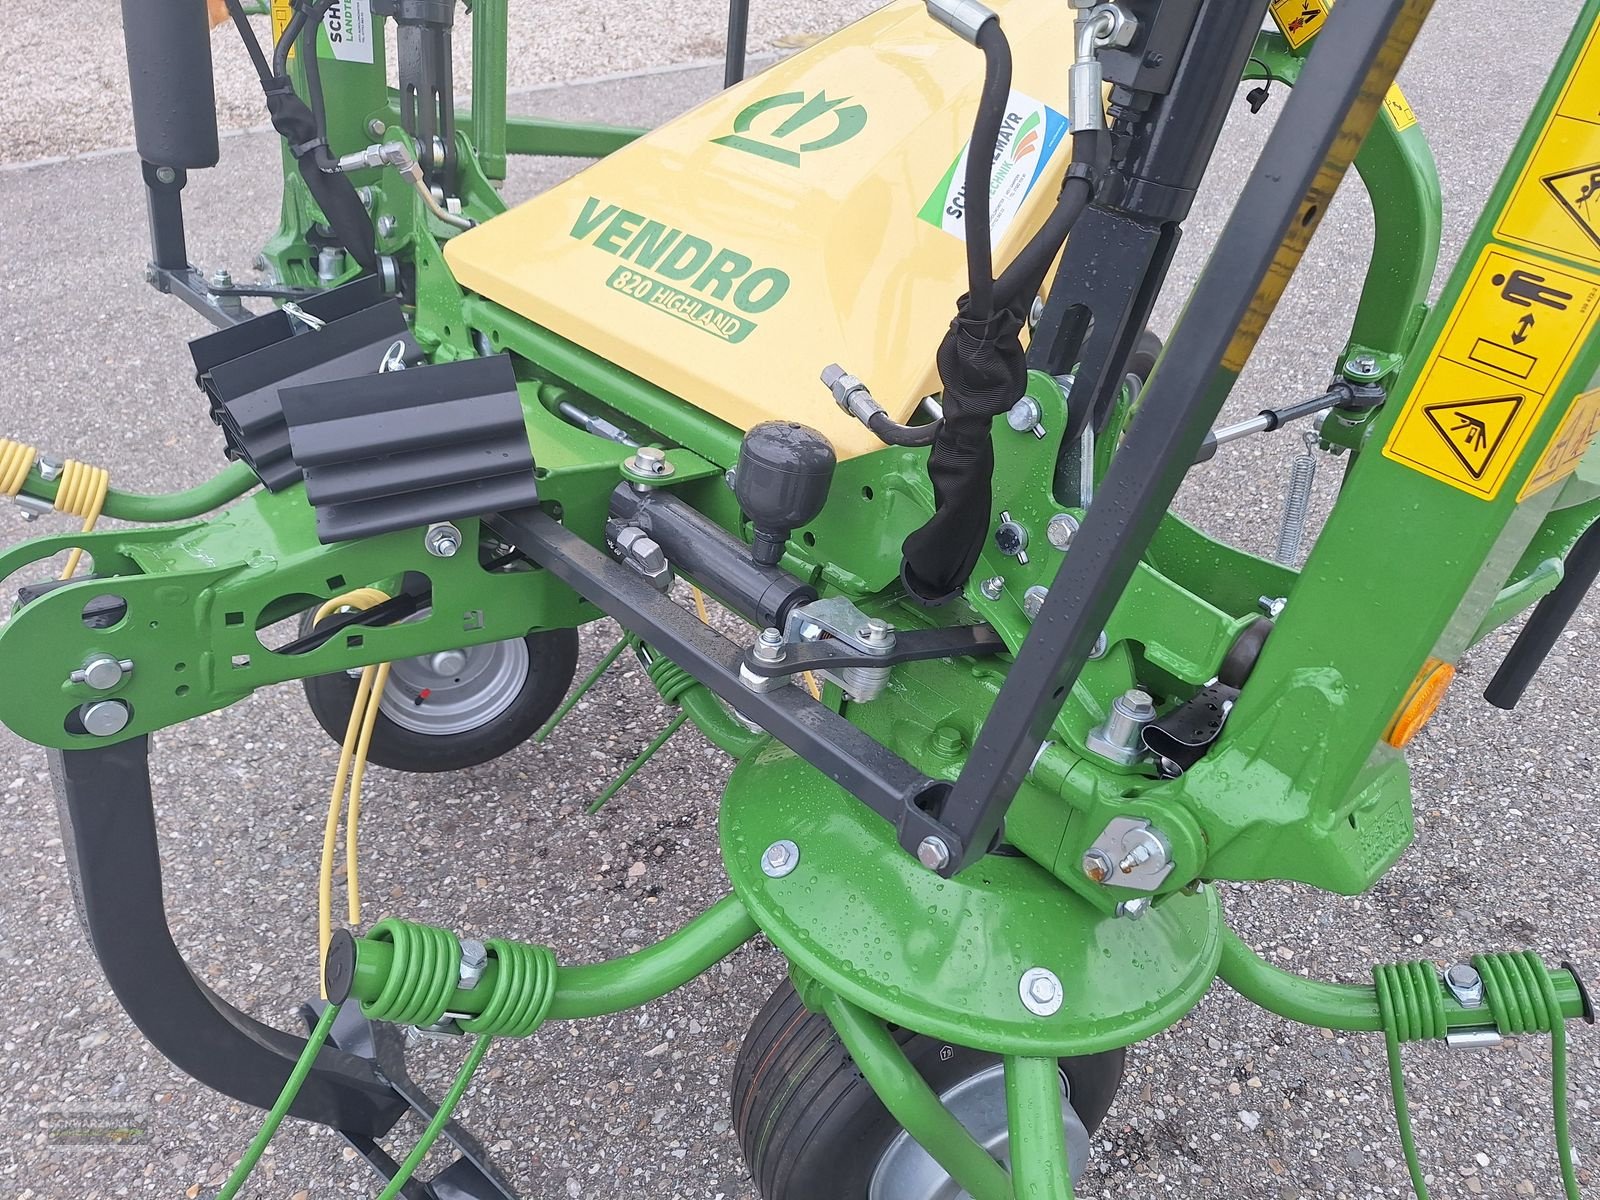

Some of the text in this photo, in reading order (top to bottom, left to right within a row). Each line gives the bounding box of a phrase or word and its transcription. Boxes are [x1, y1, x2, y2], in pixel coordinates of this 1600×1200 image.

[569, 196, 790, 314] VENDRO
[612, 271, 741, 337] 820 HIGHLAND
